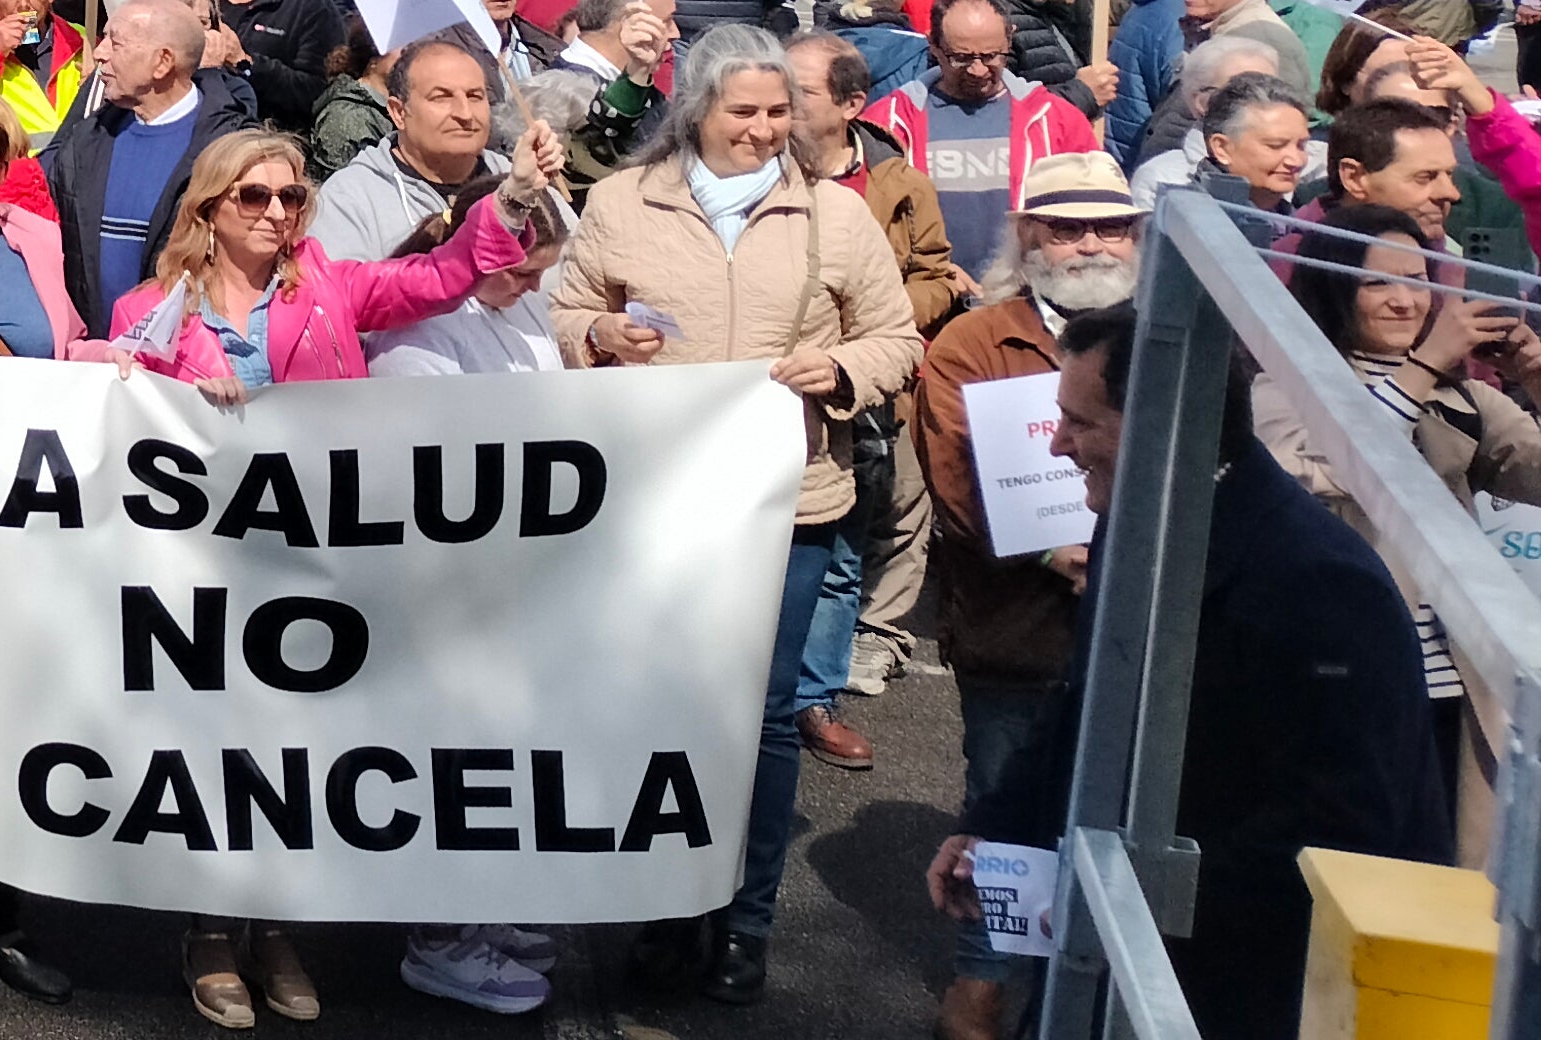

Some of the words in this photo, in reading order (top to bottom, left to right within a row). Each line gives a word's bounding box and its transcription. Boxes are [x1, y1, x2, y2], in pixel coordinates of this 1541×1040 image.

[1027, 418, 1061, 439] PR
[997, 473, 1043, 489] TENGO
[1045, 467, 1082, 482] CONS
[122, 438, 607, 548] SALUD
[121, 585, 370, 692] NO
[18, 742, 713, 853] CANCELA
[975, 856, 1029, 877] RRIO
[978, 888, 1016, 902] EMOS
[985, 915, 1027, 933] ITAL!
